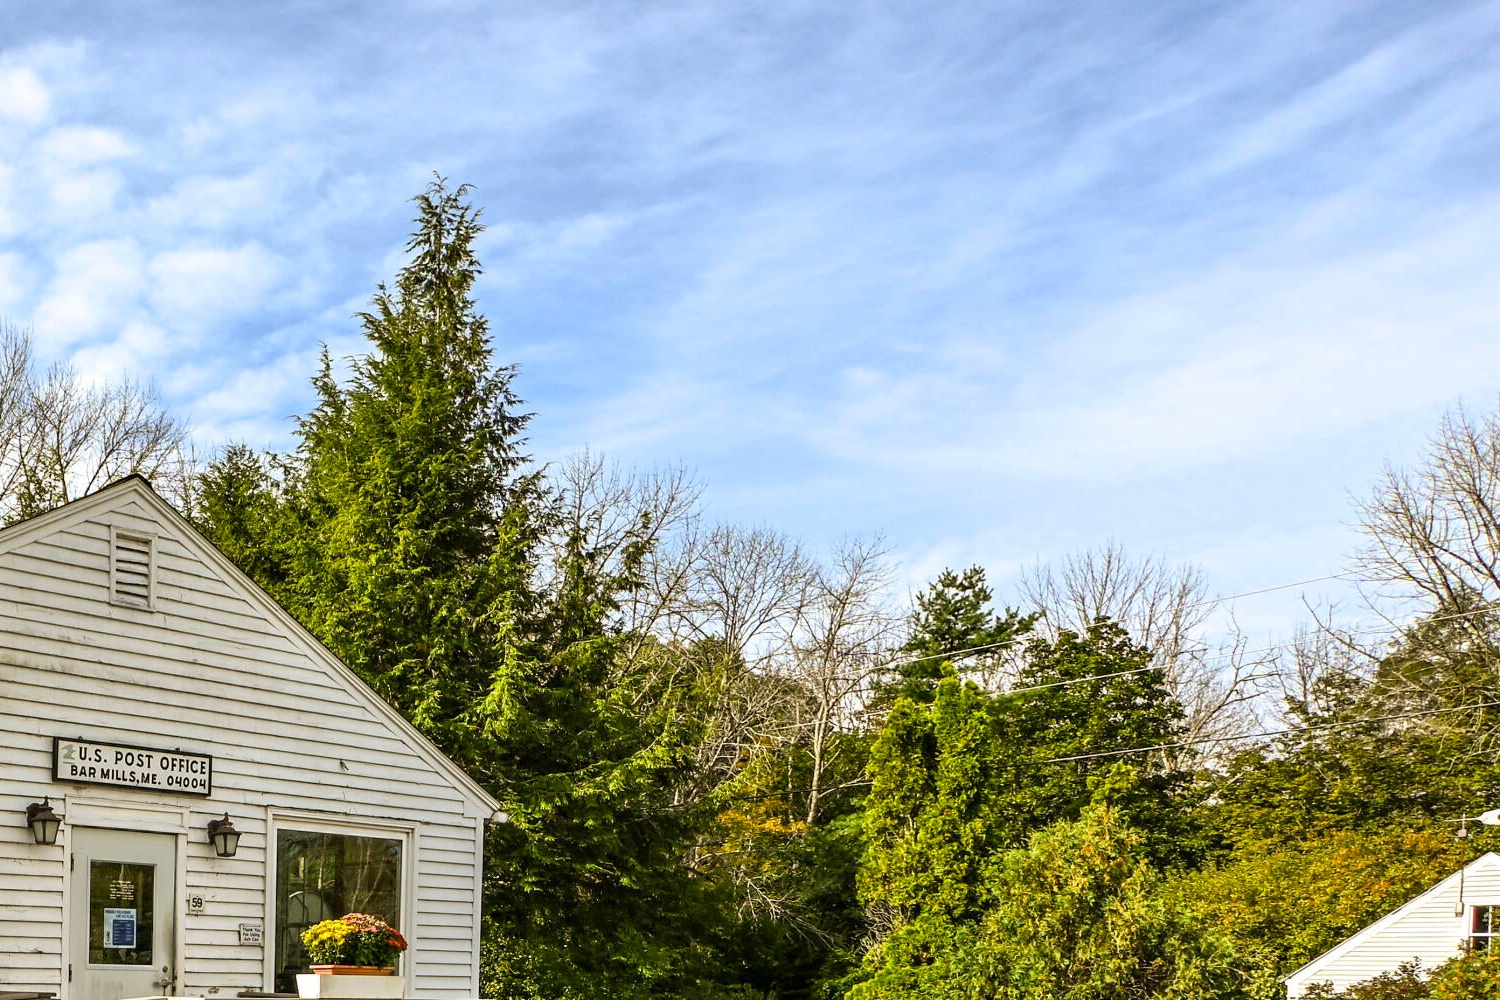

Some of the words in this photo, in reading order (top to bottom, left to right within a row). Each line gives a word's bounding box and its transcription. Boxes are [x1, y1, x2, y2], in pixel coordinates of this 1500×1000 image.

[79, 746, 108, 763] U.S.
[114, 750, 153, 768] POST
[160, 756, 206, 775] OFFICE
[70, 764, 97, 778] BAR
[167, 775, 206, 789] 04004
[192, 897, 203, 908] 59
